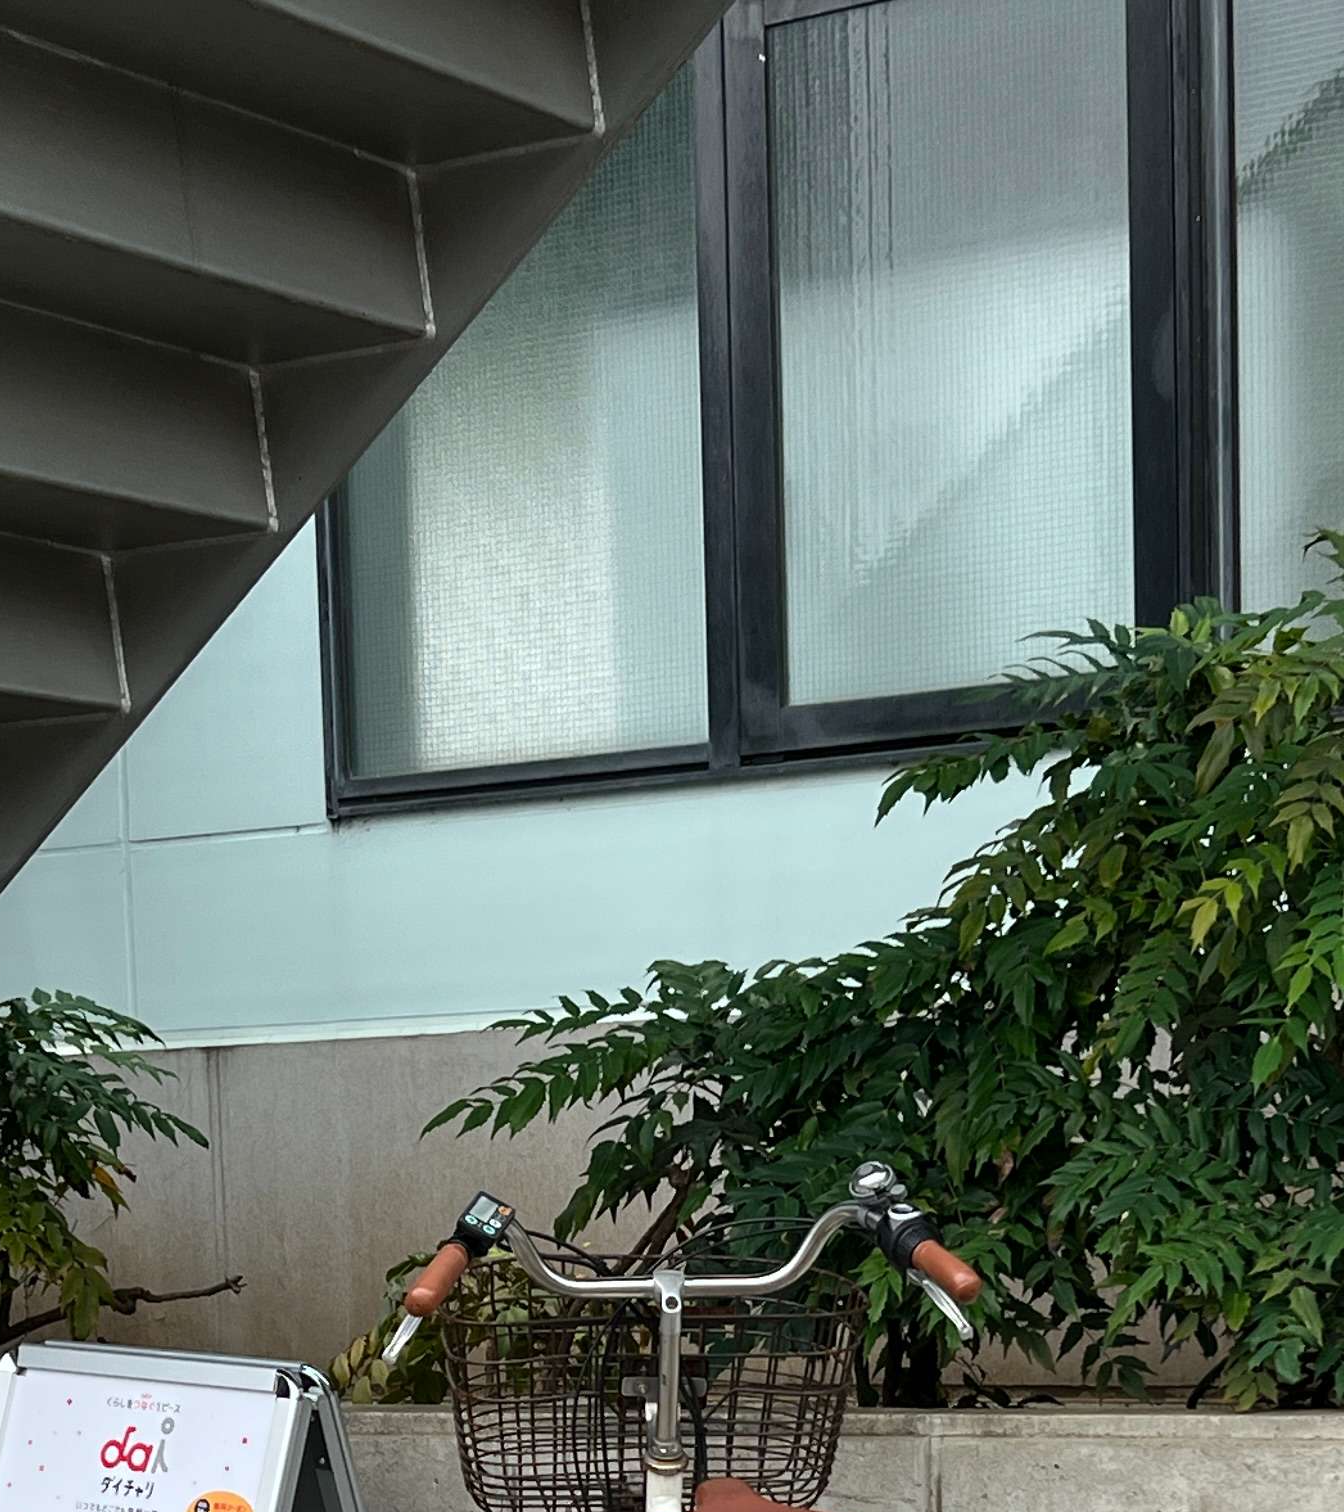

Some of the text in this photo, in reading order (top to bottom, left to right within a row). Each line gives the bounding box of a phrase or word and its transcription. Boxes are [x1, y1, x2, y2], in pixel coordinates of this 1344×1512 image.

[100, 1476, 155, 1500] ダイチャリ
